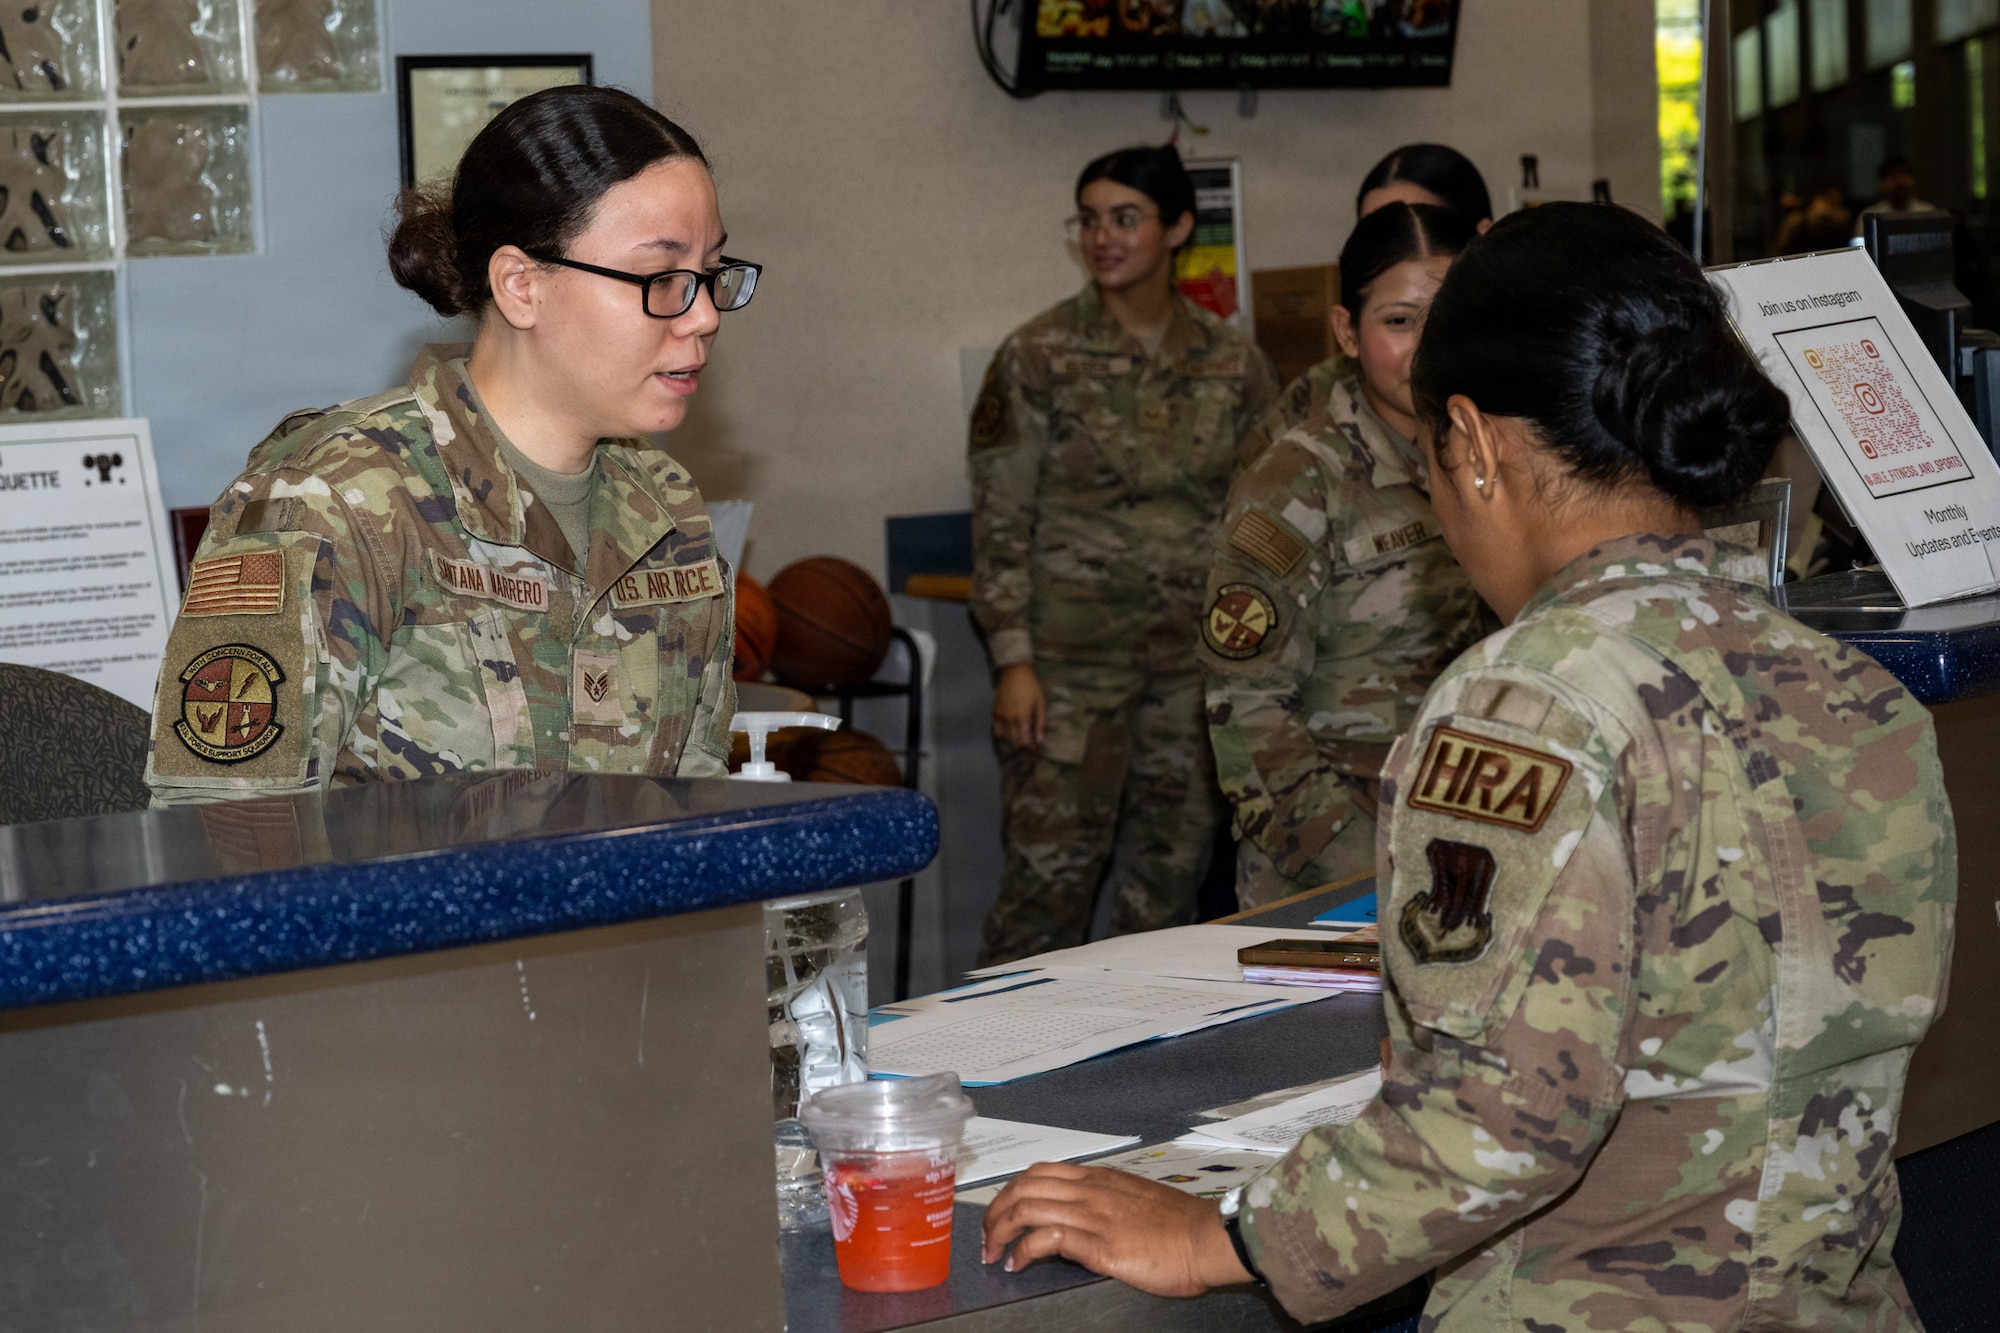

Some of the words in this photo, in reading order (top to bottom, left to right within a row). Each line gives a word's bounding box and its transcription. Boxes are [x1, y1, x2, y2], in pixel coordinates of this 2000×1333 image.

[1758, 300, 1781, 317] Join
[1784, 300, 1797, 314] us
[1798, 297, 1810, 312] on
[1809, 288, 1862, 309] Instagram
[1924, 503, 1968, 525] Monthly
[1372, 521, 1427, 554] WEAVER
[1905, 538, 1952, 560] Updates
[1951, 530, 1972, 548] and
[615, 575, 643, 603] U.S.
[647, 572, 674, 599] AIR
[189, 658, 206, 675] WITH
[206, 647, 246, 661] CONCERN
[246, 650, 262, 663] FOR
[261, 661, 273, 675] ALL
[187, 736, 209, 755] FORCE
[208, 748, 242, 759] SUPPORT
[242, 727, 276, 755] SQUADRON
[1421, 741, 1544, 820] HRA
